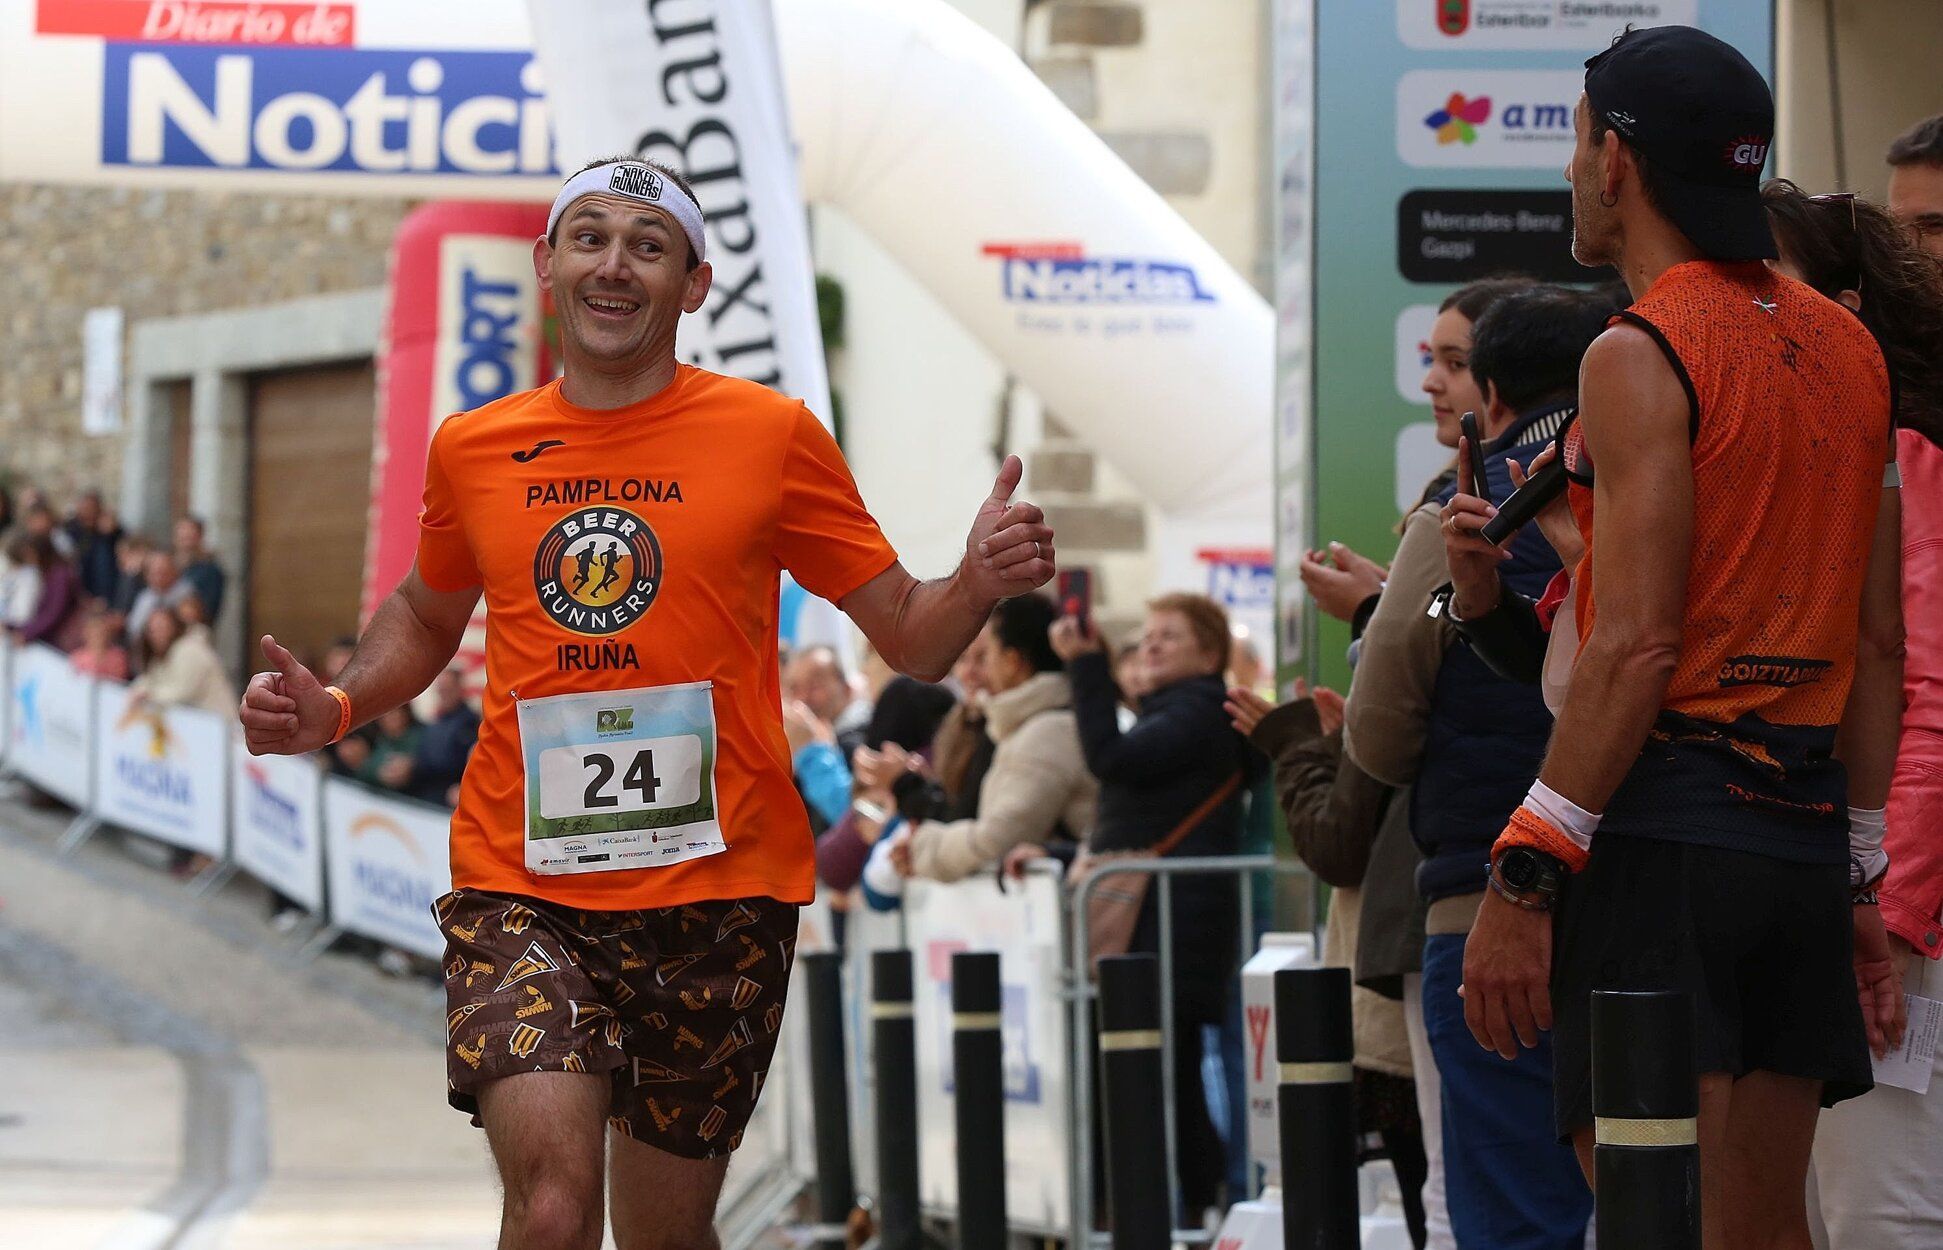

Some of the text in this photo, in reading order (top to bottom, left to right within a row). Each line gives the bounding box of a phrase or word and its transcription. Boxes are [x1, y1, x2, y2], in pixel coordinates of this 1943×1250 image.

[142, 0, 351, 44] Diario de
[1733, 144, 1765, 165] GU
[612, 176, 660, 199] RUNNERS
[623, 166, 656, 185] NAKED
[634, 0, 782, 393] ixaBan
[457, 268, 520, 411] ORT
[526, 478, 684, 509] PAMPLONA
[561, 512, 638, 539] BEER
[541, 579, 654, 629] RUNNERS
[557, 638, 641, 672] IRUÑA
[583, 749, 662, 809] 24
[515, 1001, 553, 1020] HAWKS
